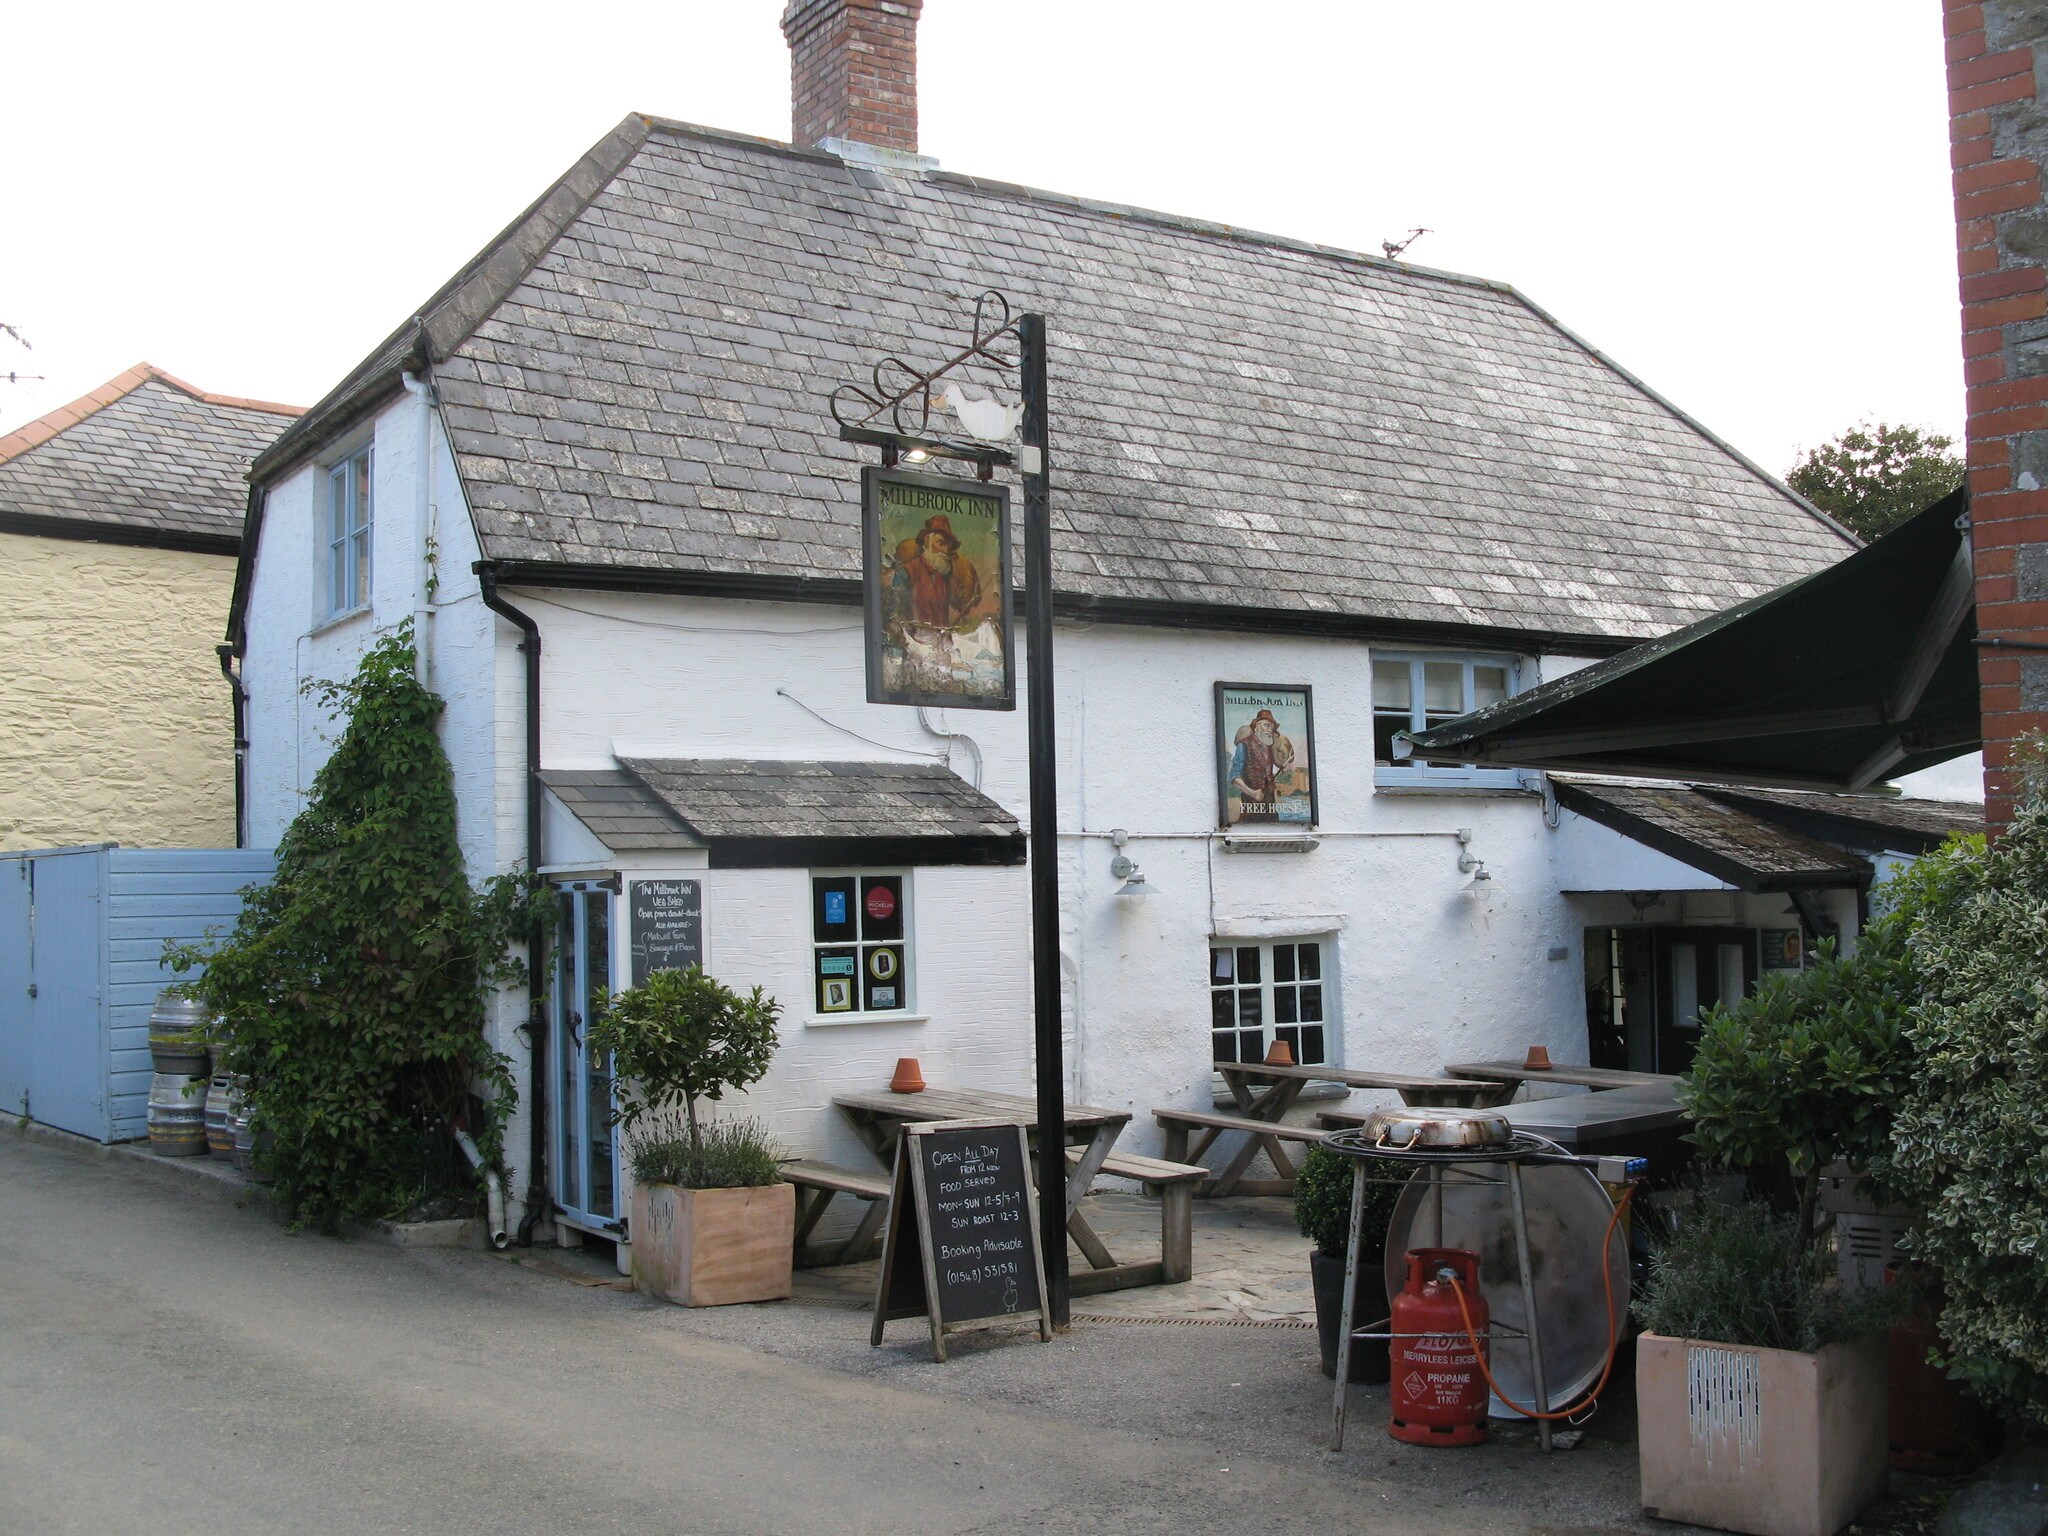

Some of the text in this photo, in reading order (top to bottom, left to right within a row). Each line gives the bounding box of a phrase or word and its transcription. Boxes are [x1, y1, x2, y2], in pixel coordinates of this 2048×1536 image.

[881, 487, 995, 519] MILLBROOK INN
[1240, 802, 1303, 814] FREE HOUSE
[638, 882, 652, 895] The
[667, 896, 684, 907] SHED
[638, 907, 653, 919] Open
[932, 1145, 1000, 1168] OPEN ALL DAY
[960, 1165, 976, 1175] FROM
[978, 1163, 985, 1172] 12
[940, 1181, 962, 1194] FOOD
[938, 1191, 1020, 1213] MON-SUN 12-5/7-9
[952, 1210, 1019, 1229] SUN ROAST 12-3
[941, 1236, 1024, 1260] Booking Advisable
[947, 1262, 1018, 1286] (01548) 531581
[1403, 1349, 1448, 1365] MERRYLEES
[1427, 1373, 1470, 1383] PROPANE
[1437, 1396, 1459, 1405] 11KG
